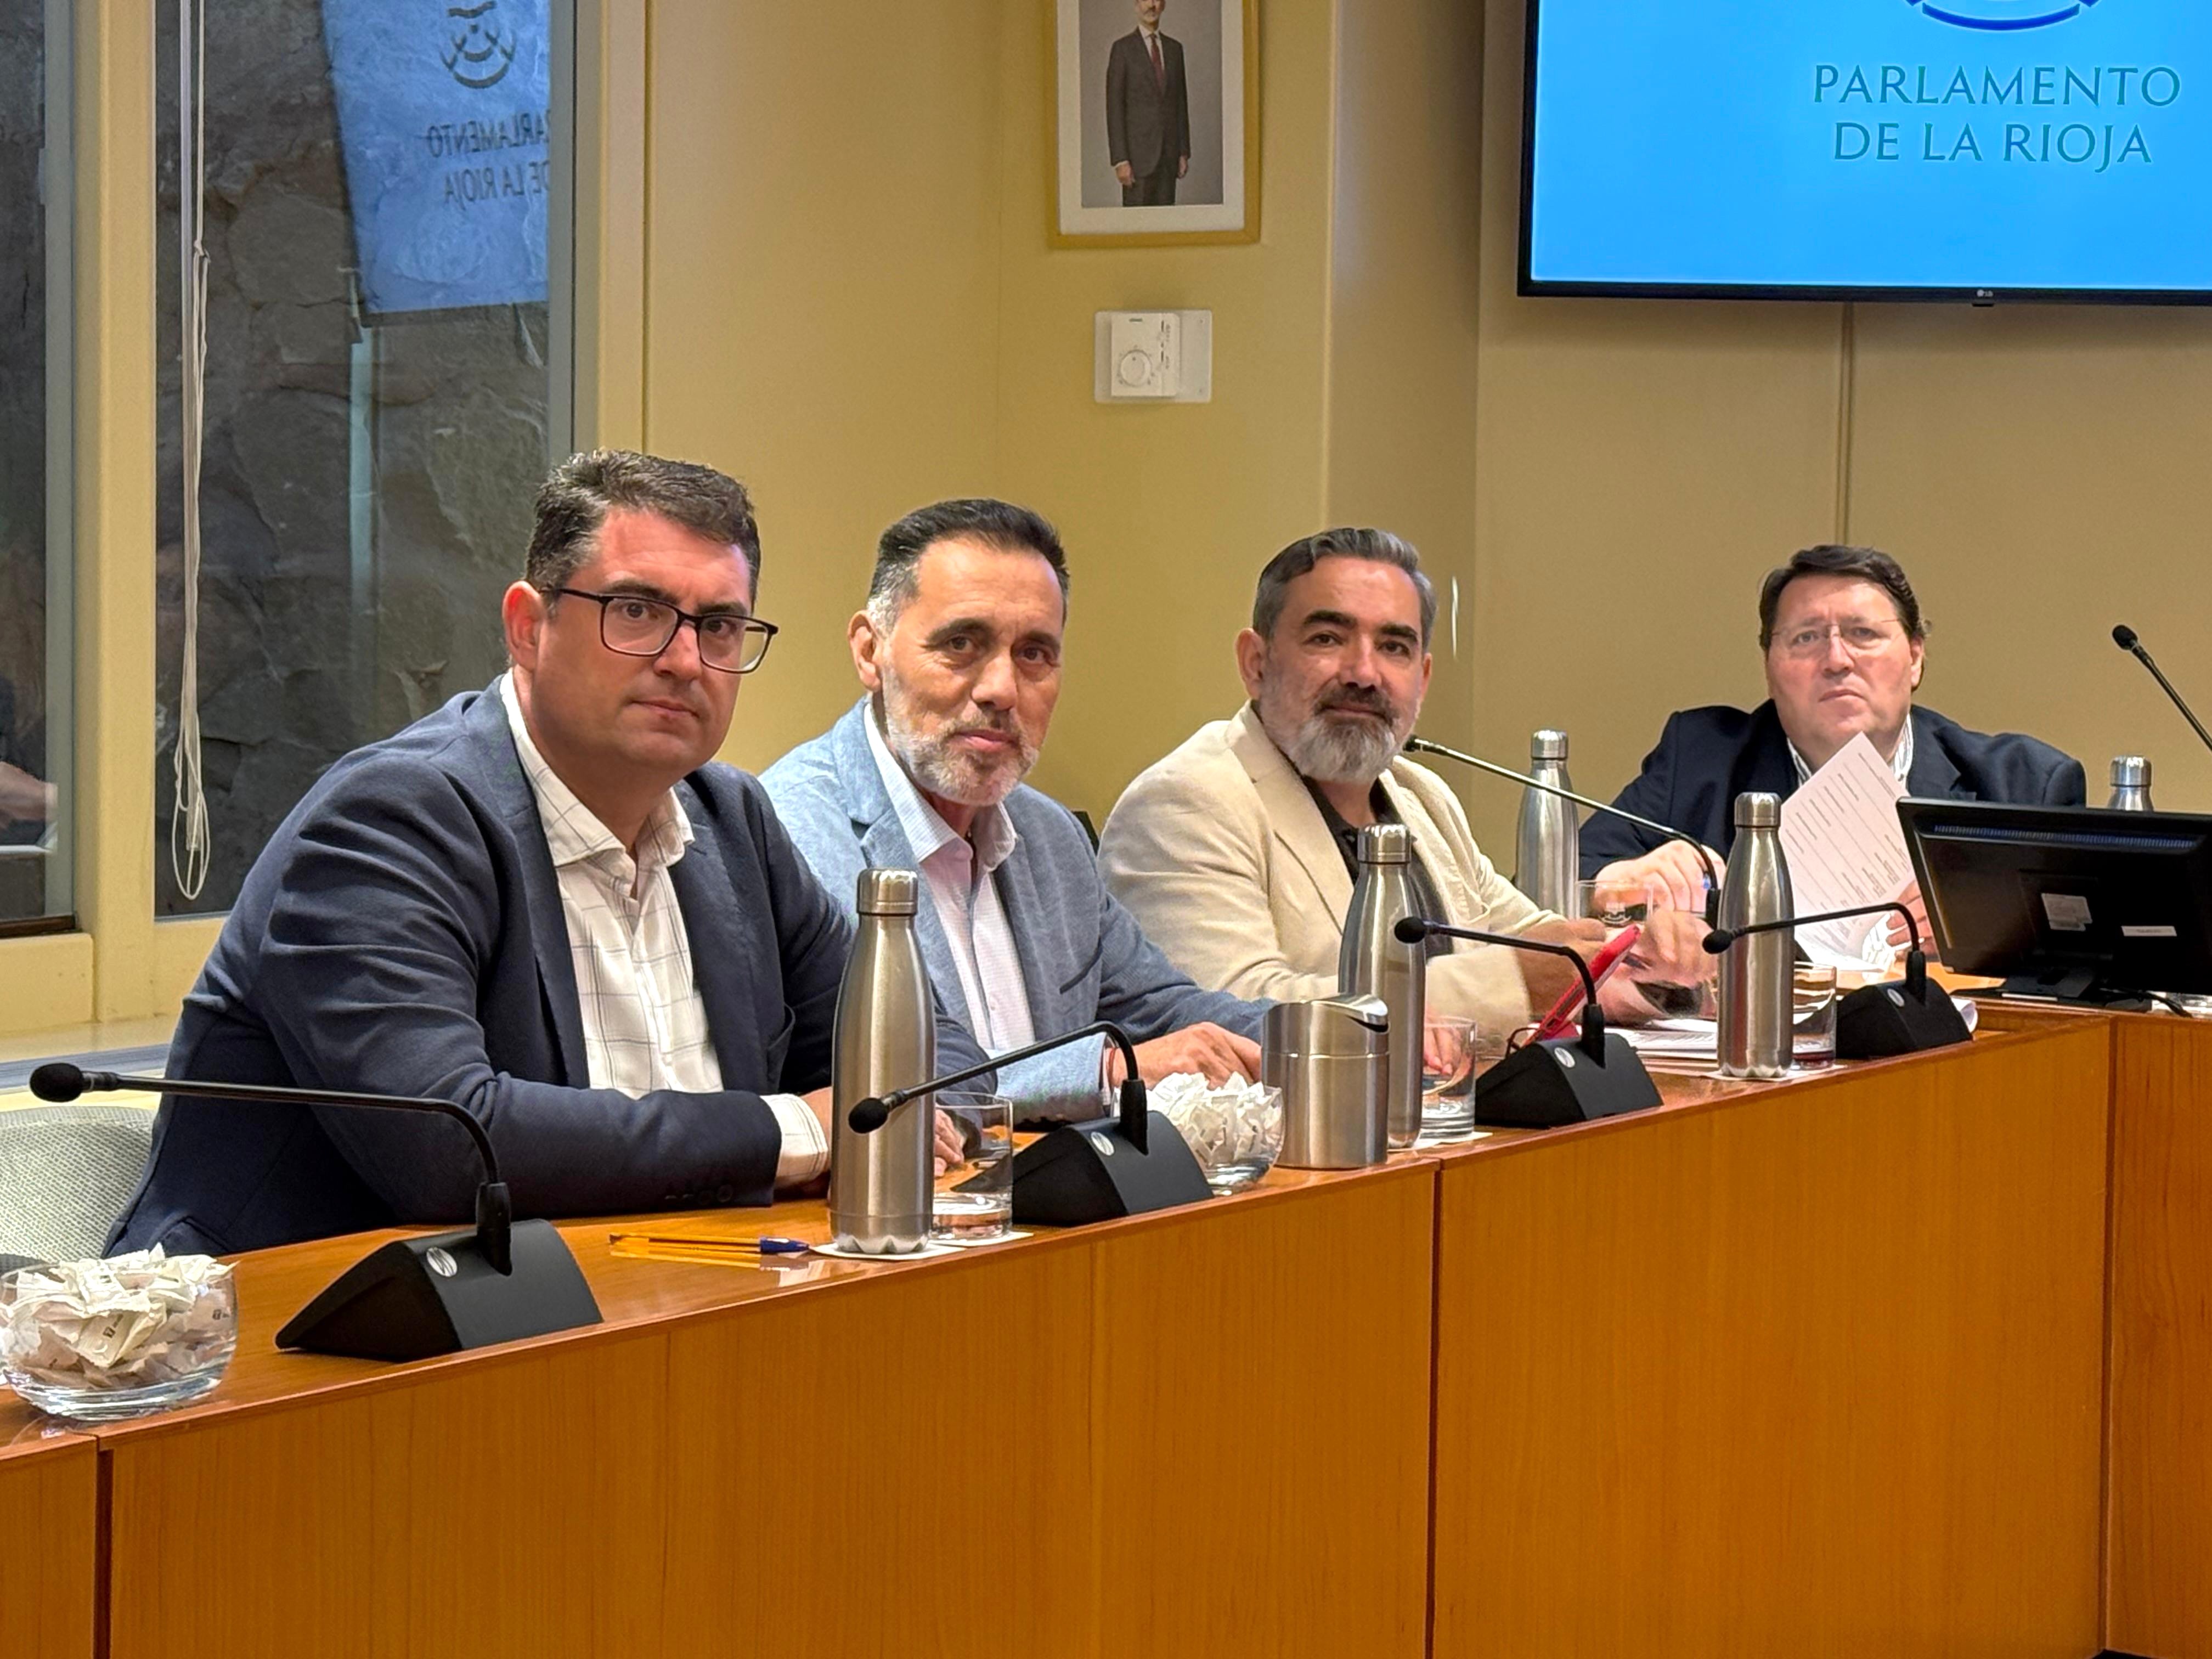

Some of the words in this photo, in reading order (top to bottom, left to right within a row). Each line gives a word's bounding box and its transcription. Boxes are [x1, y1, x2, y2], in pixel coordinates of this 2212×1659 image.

[1814, 65, 2180, 106] PARLAMENTO
[1835, 122, 1899, 160] DE
[1923, 123, 1982, 161] LA
[2004, 124, 2152, 173] RIOJA
